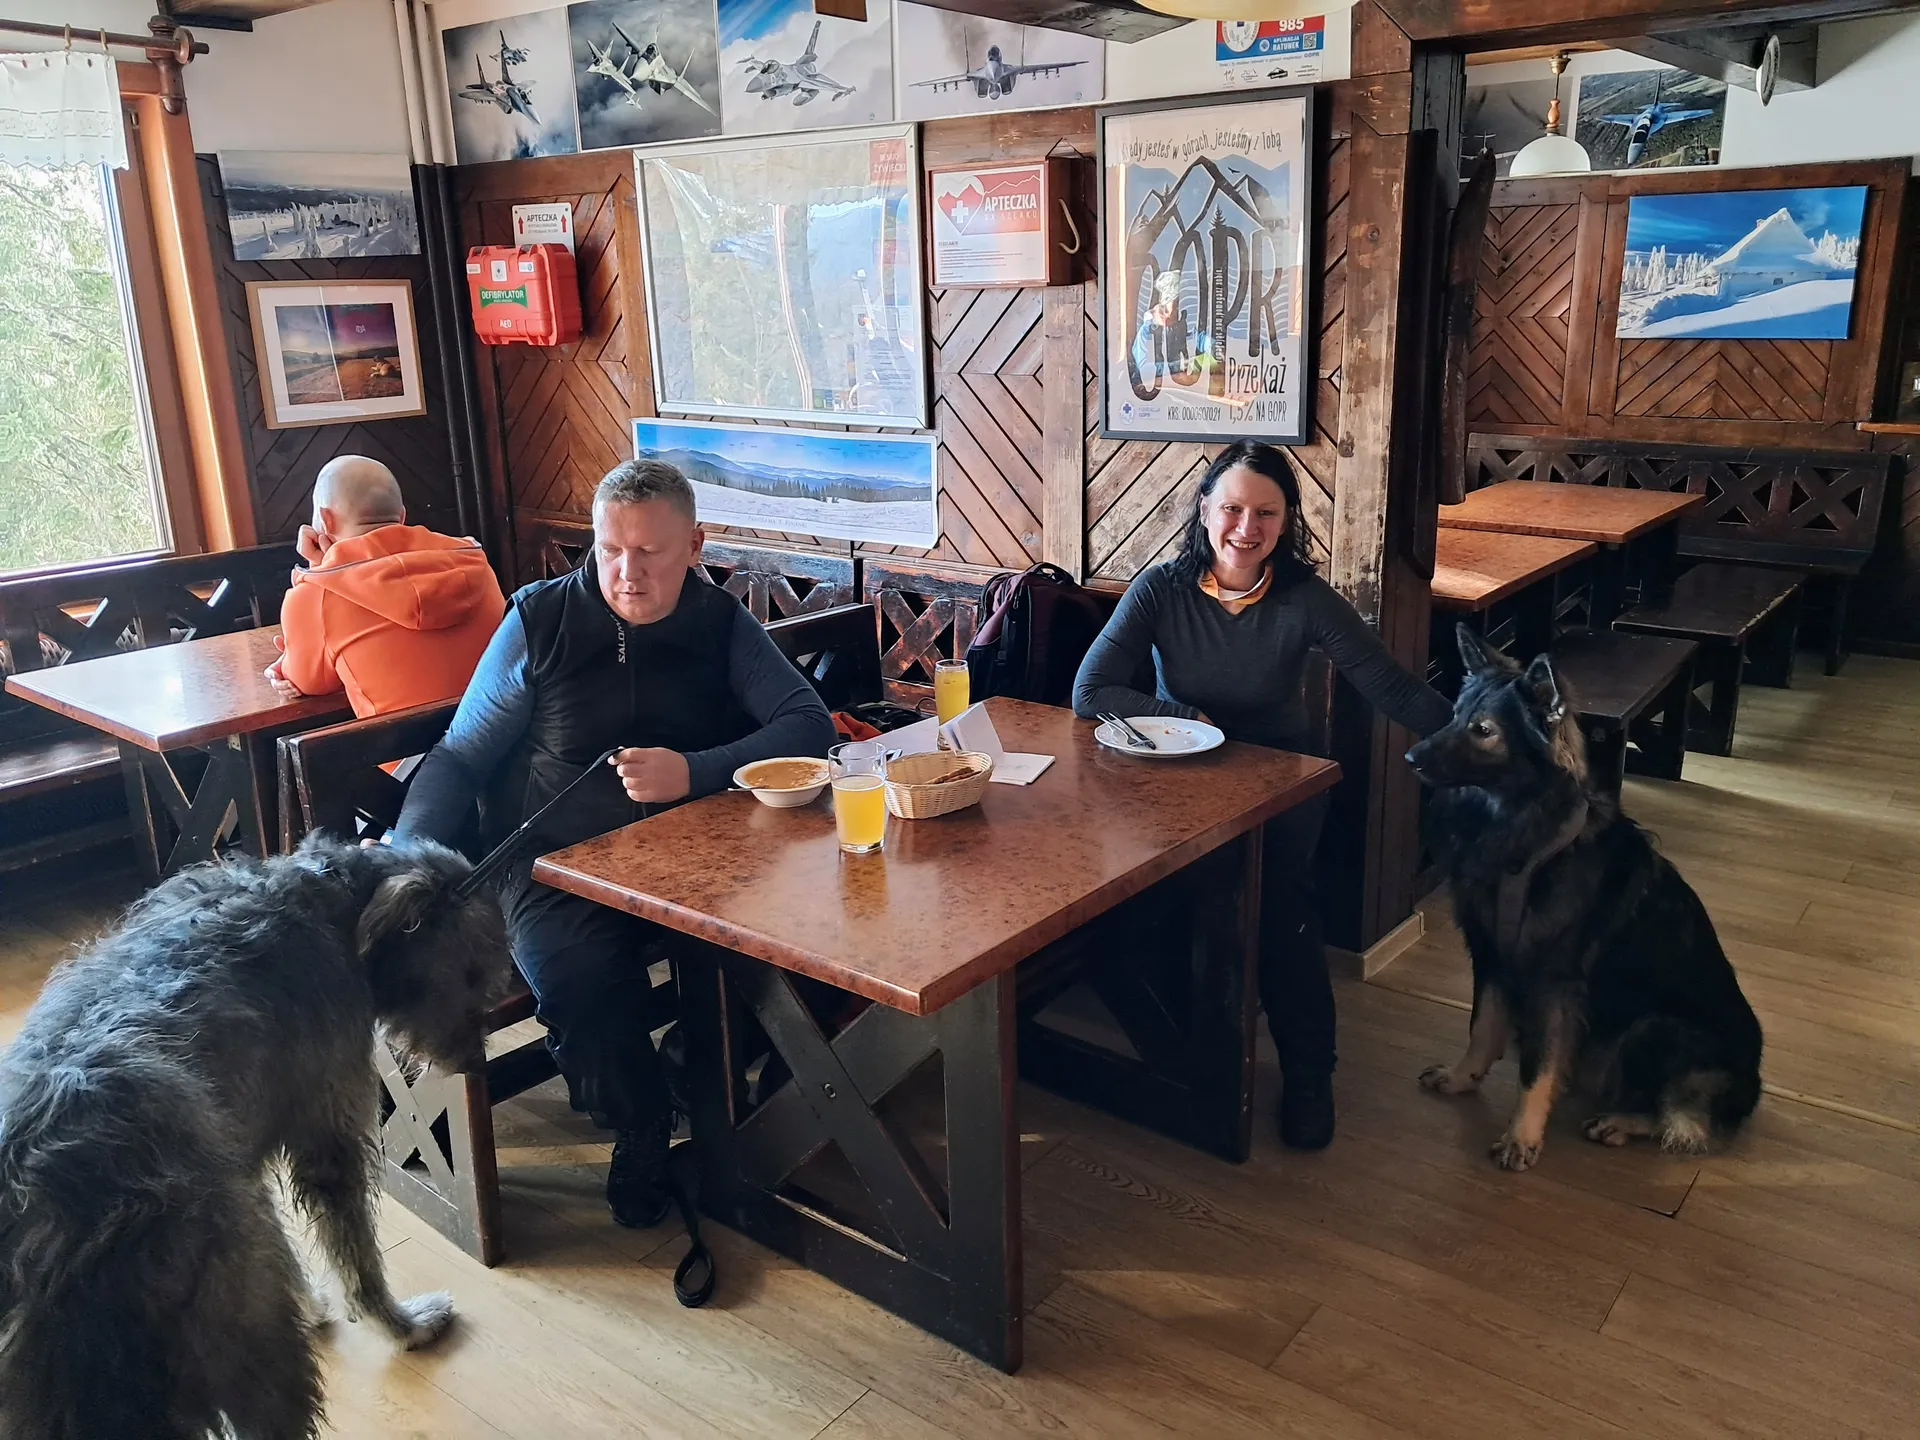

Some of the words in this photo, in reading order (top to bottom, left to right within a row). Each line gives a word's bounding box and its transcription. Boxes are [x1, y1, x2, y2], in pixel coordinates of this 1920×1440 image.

[1279, 18, 1304, 32] 985
[1273, 35, 1300, 43] APLIKACJA
[1272, 41, 1300, 52] RATUNEK
[1143, 138, 1173, 162] jesteś
[1172, 145, 1180, 160] w
[1212, 127, 1252, 155] jesteśmy
[1253, 135, 1260, 151] z
[1262, 129, 1283, 153] Tobą
[984, 193, 1037, 212] APTECZKA
[526, 213, 558, 222] APTECZKA
[1001, 211, 1037, 221] SZLAKU
[481, 290, 524, 299] DEFIBRYLATOR
[500, 320, 512, 328] AED
[1228, 344, 1287, 395] Przekaż
[1167, 406, 1181, 422] KRS:
[1255, 401, 1267, 422] NA
[1267, 400, 1288, 423] GOPR
